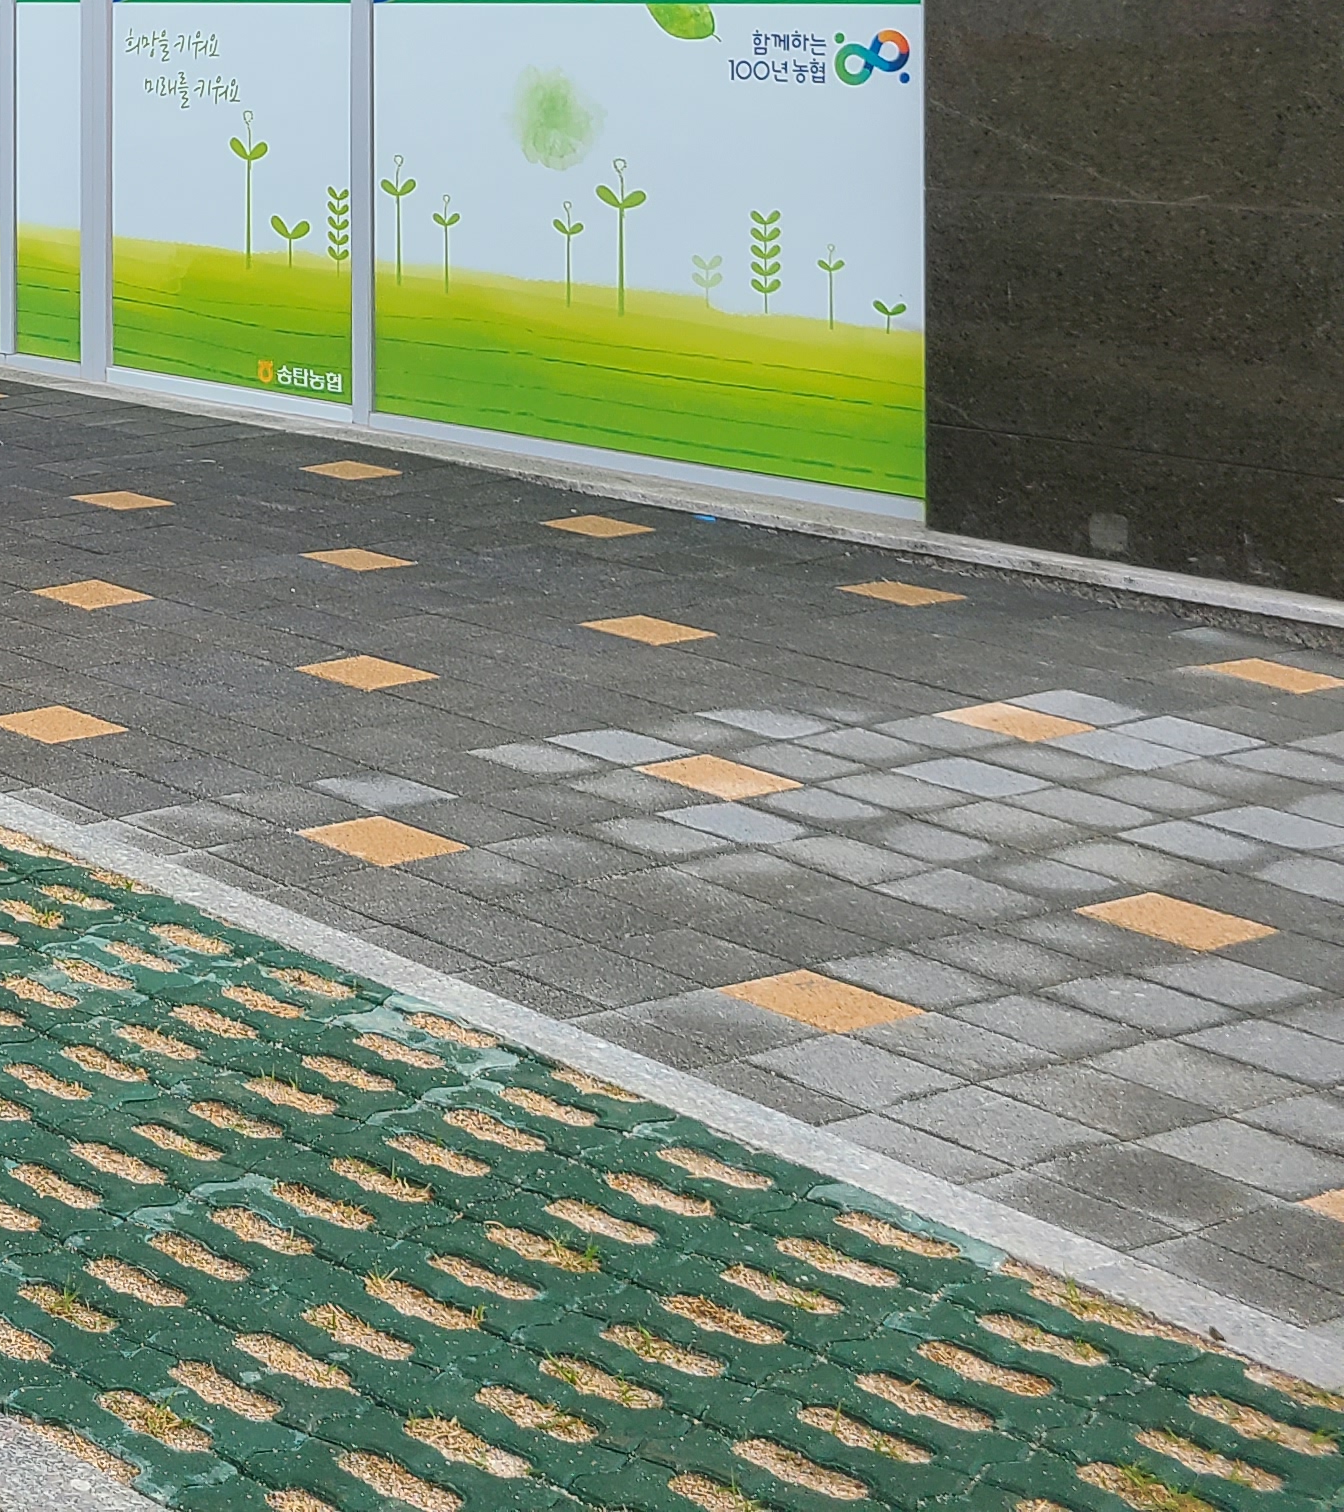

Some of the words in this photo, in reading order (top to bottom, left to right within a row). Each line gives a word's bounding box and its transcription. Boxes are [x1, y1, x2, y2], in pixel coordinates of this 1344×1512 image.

[125, 28, 170, 62] 희망을
[174, 30, 220, 59] 키워요
[751, 29, 827, 57] 함께하는
[728, 59, 789, 83] 100년
[792, 61, 827, 85] 농협
[144, 71, 190, 109] 미래를
[194, 76, 241, 105] 키워요
[276, 364, 343, 393] 송탄농협
